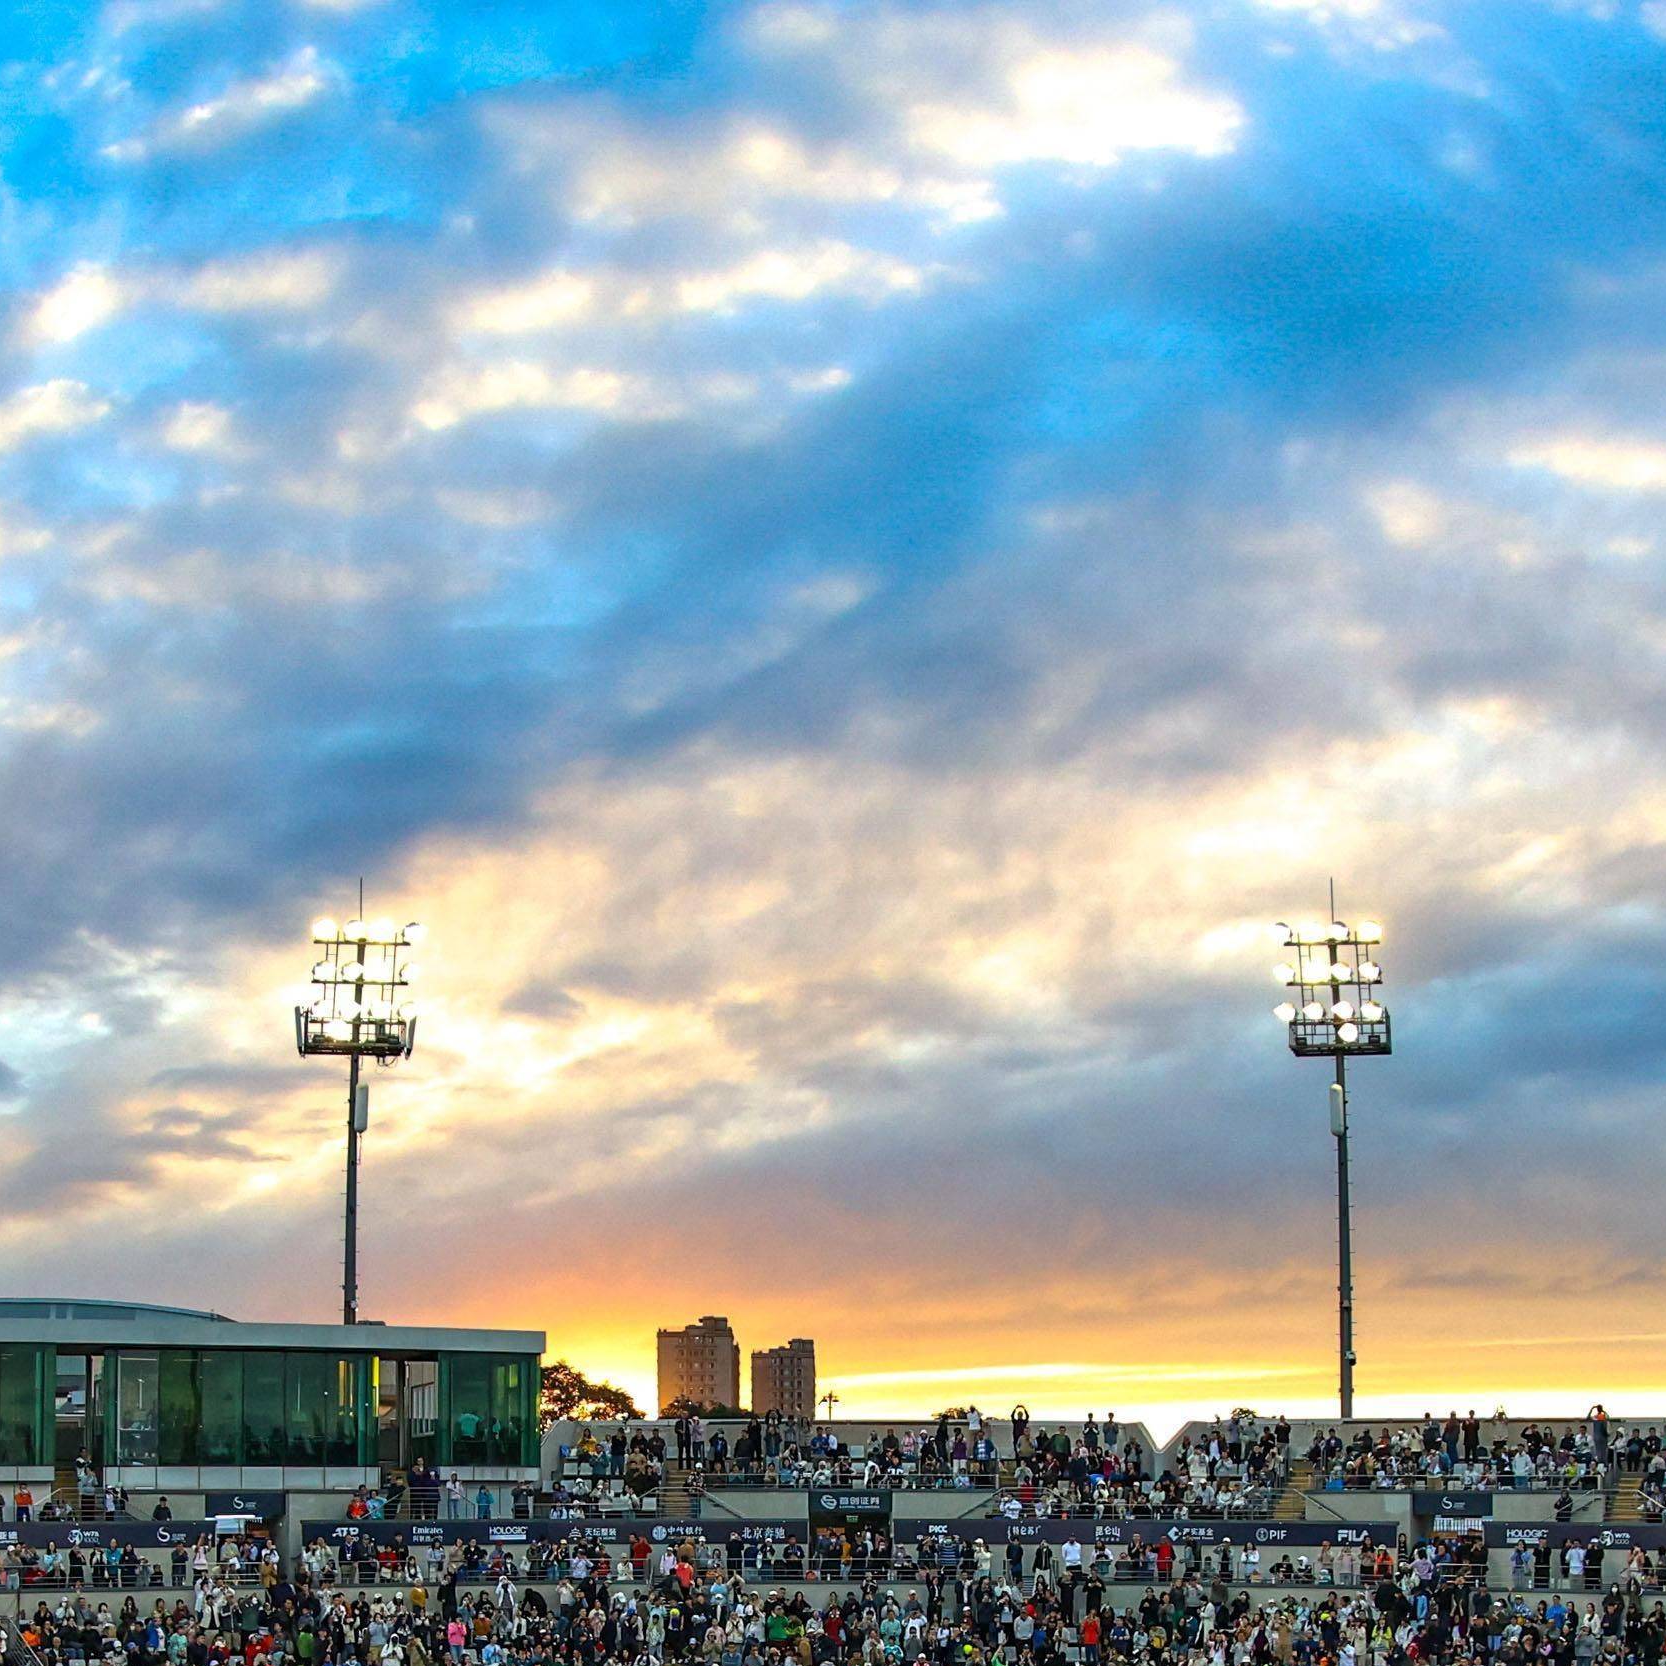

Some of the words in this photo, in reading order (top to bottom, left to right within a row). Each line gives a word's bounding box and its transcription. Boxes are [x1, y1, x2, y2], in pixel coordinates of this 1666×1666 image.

[332, 1527, 359, 1538] ATP
[489, 1526, 527, 1534] HOLOGIC
[742, 1527, 785, 1539] 北京奔驰
[928, 1525, 947, 1533] PICC
[1096, 1526, 1120, 1537] 昆仑山
[1507, 1529, 1547, 1538] HOLOGIC
[1270, 1530, 1287, 1540] PIF
[1338, 1530, 1369, 1542] FILA
